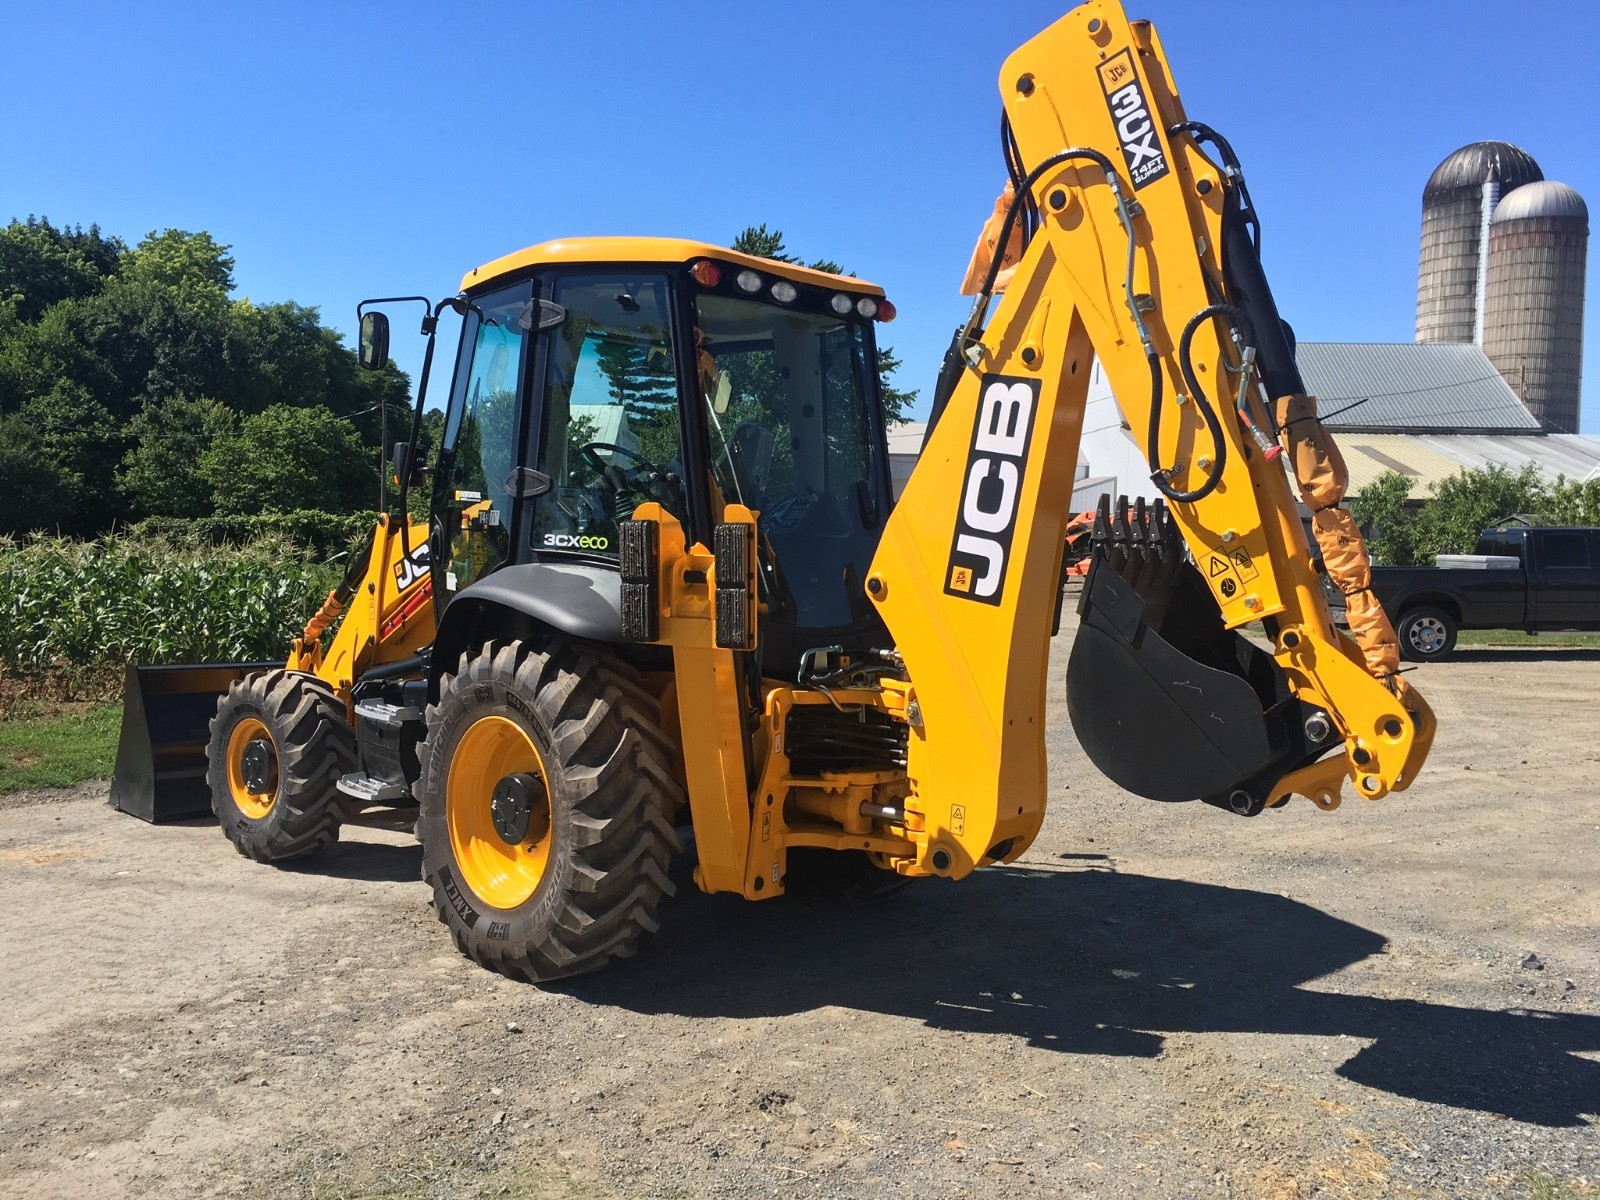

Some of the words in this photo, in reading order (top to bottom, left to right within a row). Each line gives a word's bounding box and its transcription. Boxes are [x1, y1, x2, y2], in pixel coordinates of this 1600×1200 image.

[1108, 64, 1128, 83] JCB
[1111, 84, 1162, 171] 3CX
[1132, 155, 1163, 178] 14FT
[1135, 163, 1165, 184] SUPER
[957, 382, 1034, 597] JCB
